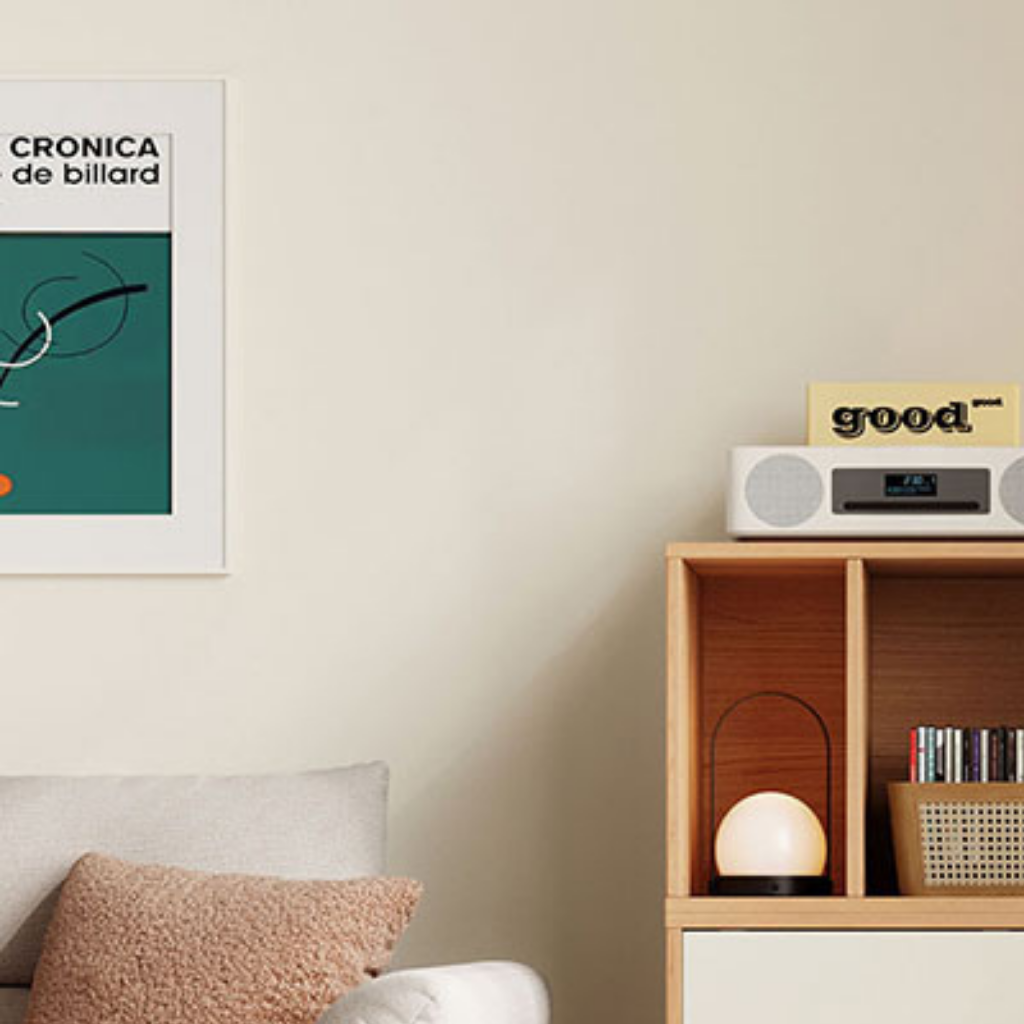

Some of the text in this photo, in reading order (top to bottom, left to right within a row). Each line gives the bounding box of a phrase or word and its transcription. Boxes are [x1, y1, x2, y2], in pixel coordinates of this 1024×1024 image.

[10, 136, 160, 158] CRONICA
[12, 163, 160, 185] de billard
[832, 401, 973, 439] good
